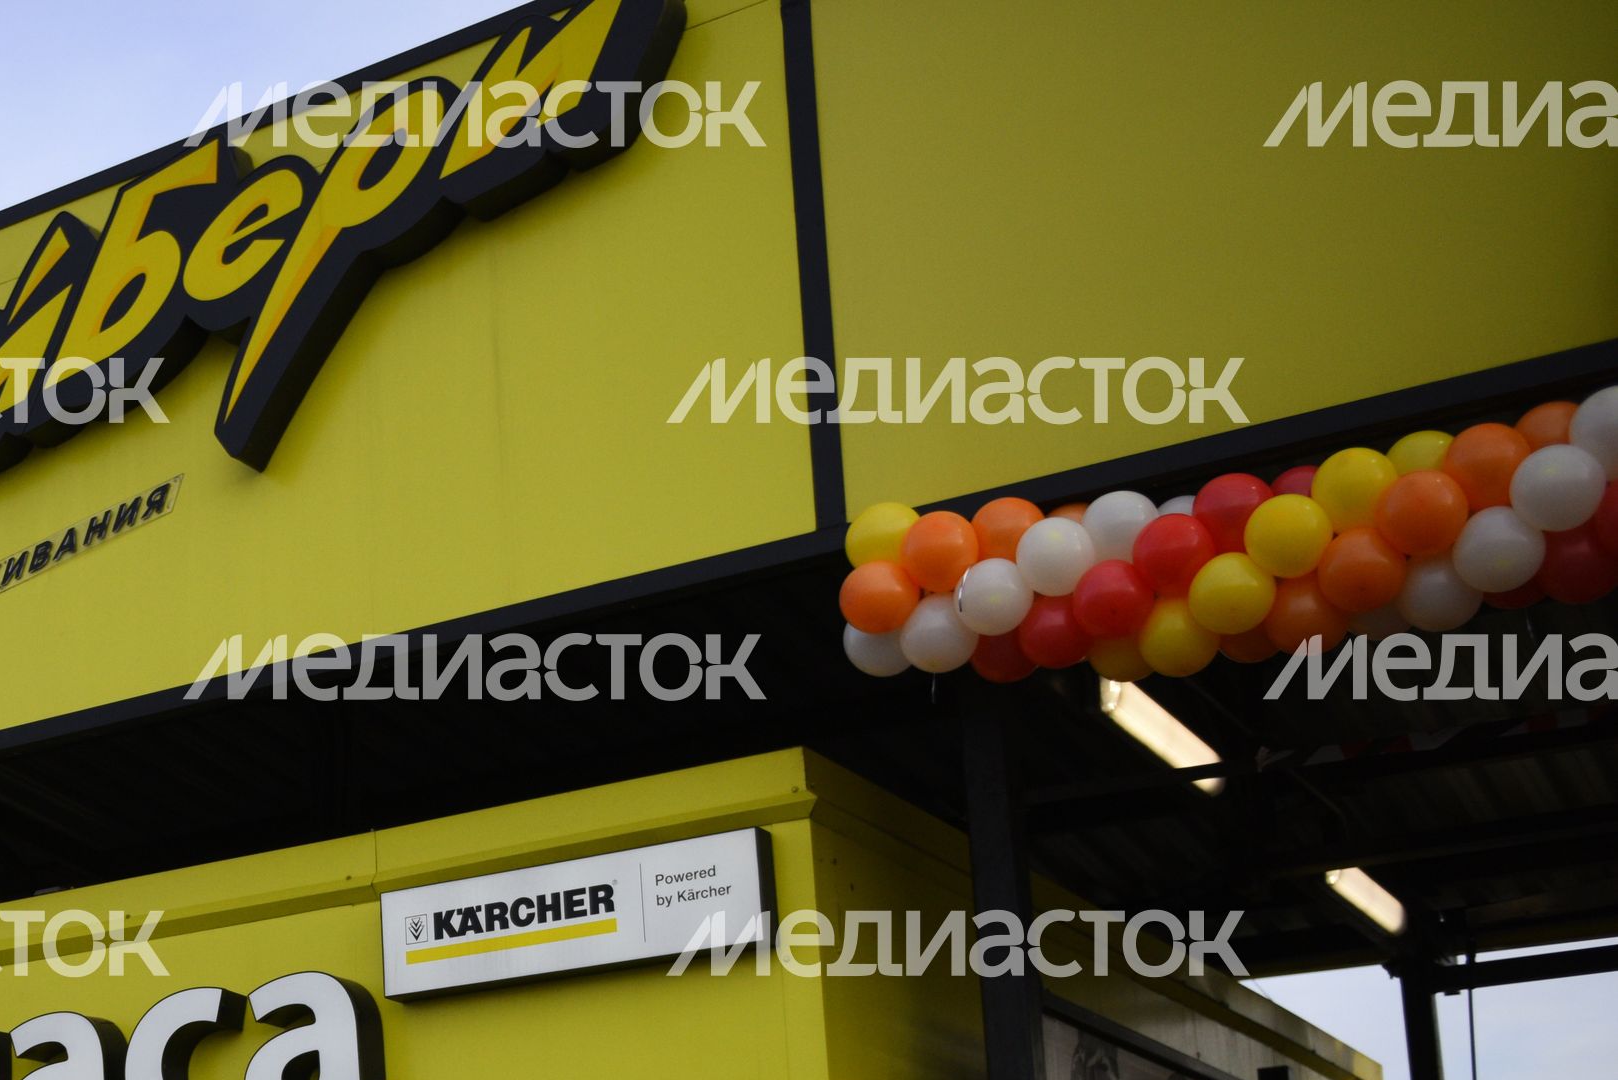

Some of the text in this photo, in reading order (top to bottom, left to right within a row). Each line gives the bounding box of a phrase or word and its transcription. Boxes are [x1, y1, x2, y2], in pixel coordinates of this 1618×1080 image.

[655, 865, 717, 887] Powered
[656, 883, 732, 909] by Kärcher
[433, 883, 615, 941] KÄRCHER
